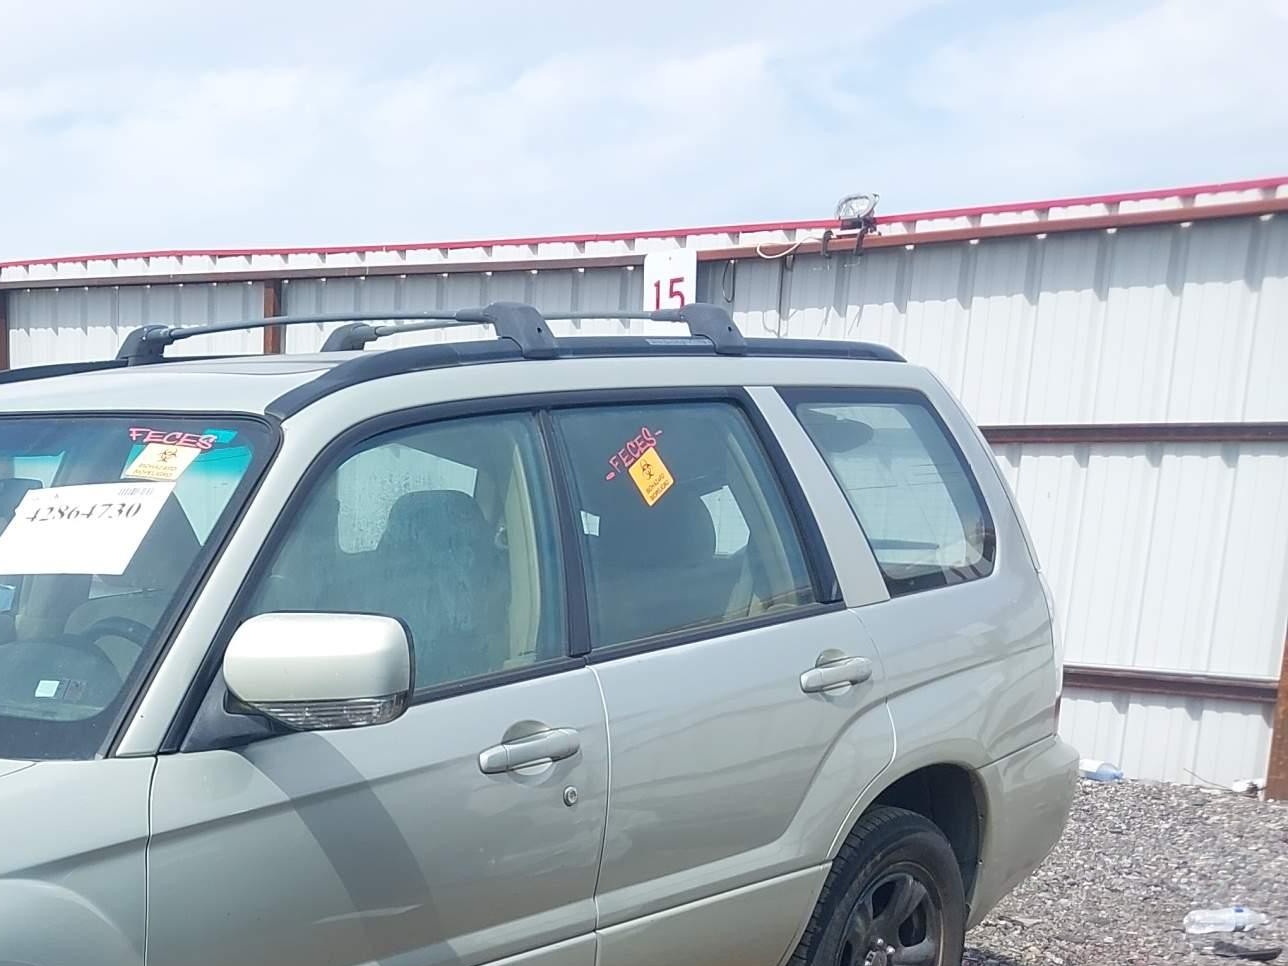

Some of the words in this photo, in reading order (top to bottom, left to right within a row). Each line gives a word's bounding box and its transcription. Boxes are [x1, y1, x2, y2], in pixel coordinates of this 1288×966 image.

[653, 276, 685, 311] 15
[128, 427, 218, 450] FECES
[25, 502, 143, 522] 42864730
